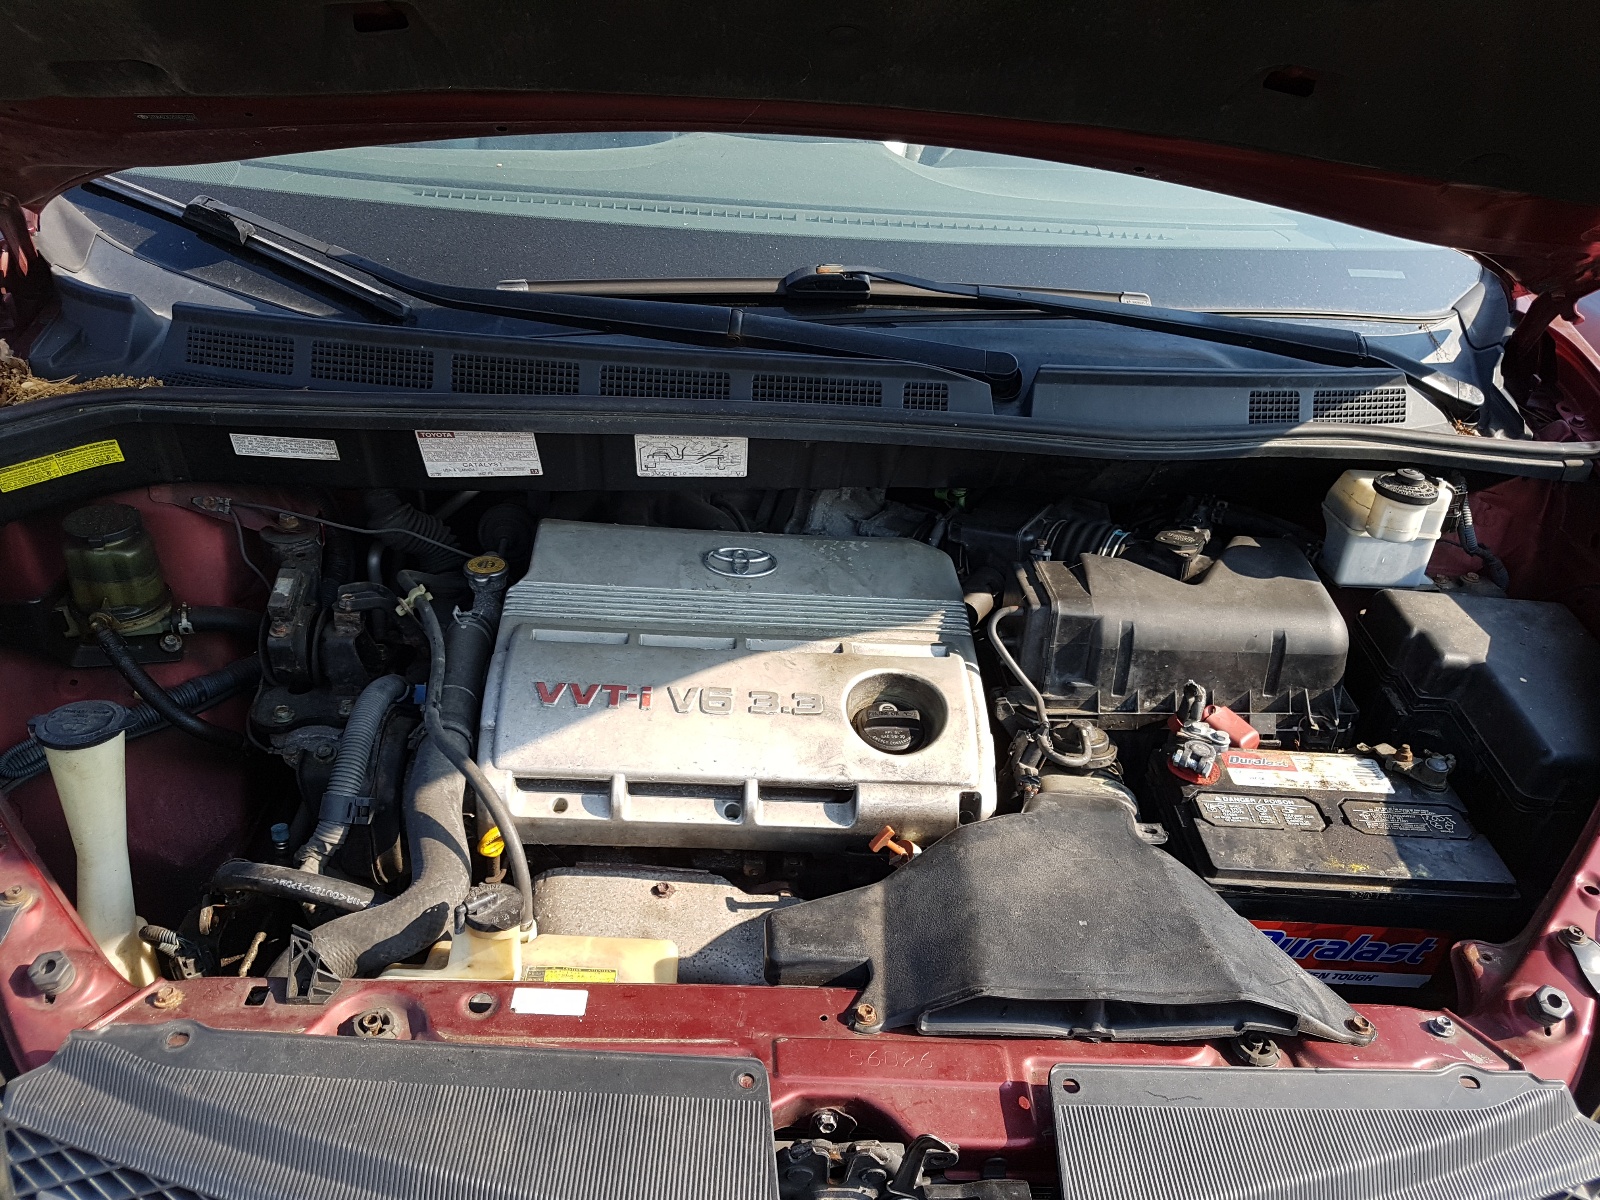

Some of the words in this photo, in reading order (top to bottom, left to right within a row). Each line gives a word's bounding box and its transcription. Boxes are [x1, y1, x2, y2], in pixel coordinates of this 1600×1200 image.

[535, 681, 652, 710] VVT-i
[667, 686, 734, 715] V6
[748, 690, 824, 715] 3.3
[1229, 755, 1288, 768] Duralast
[1222, 796, 1256, 804] DANGER
